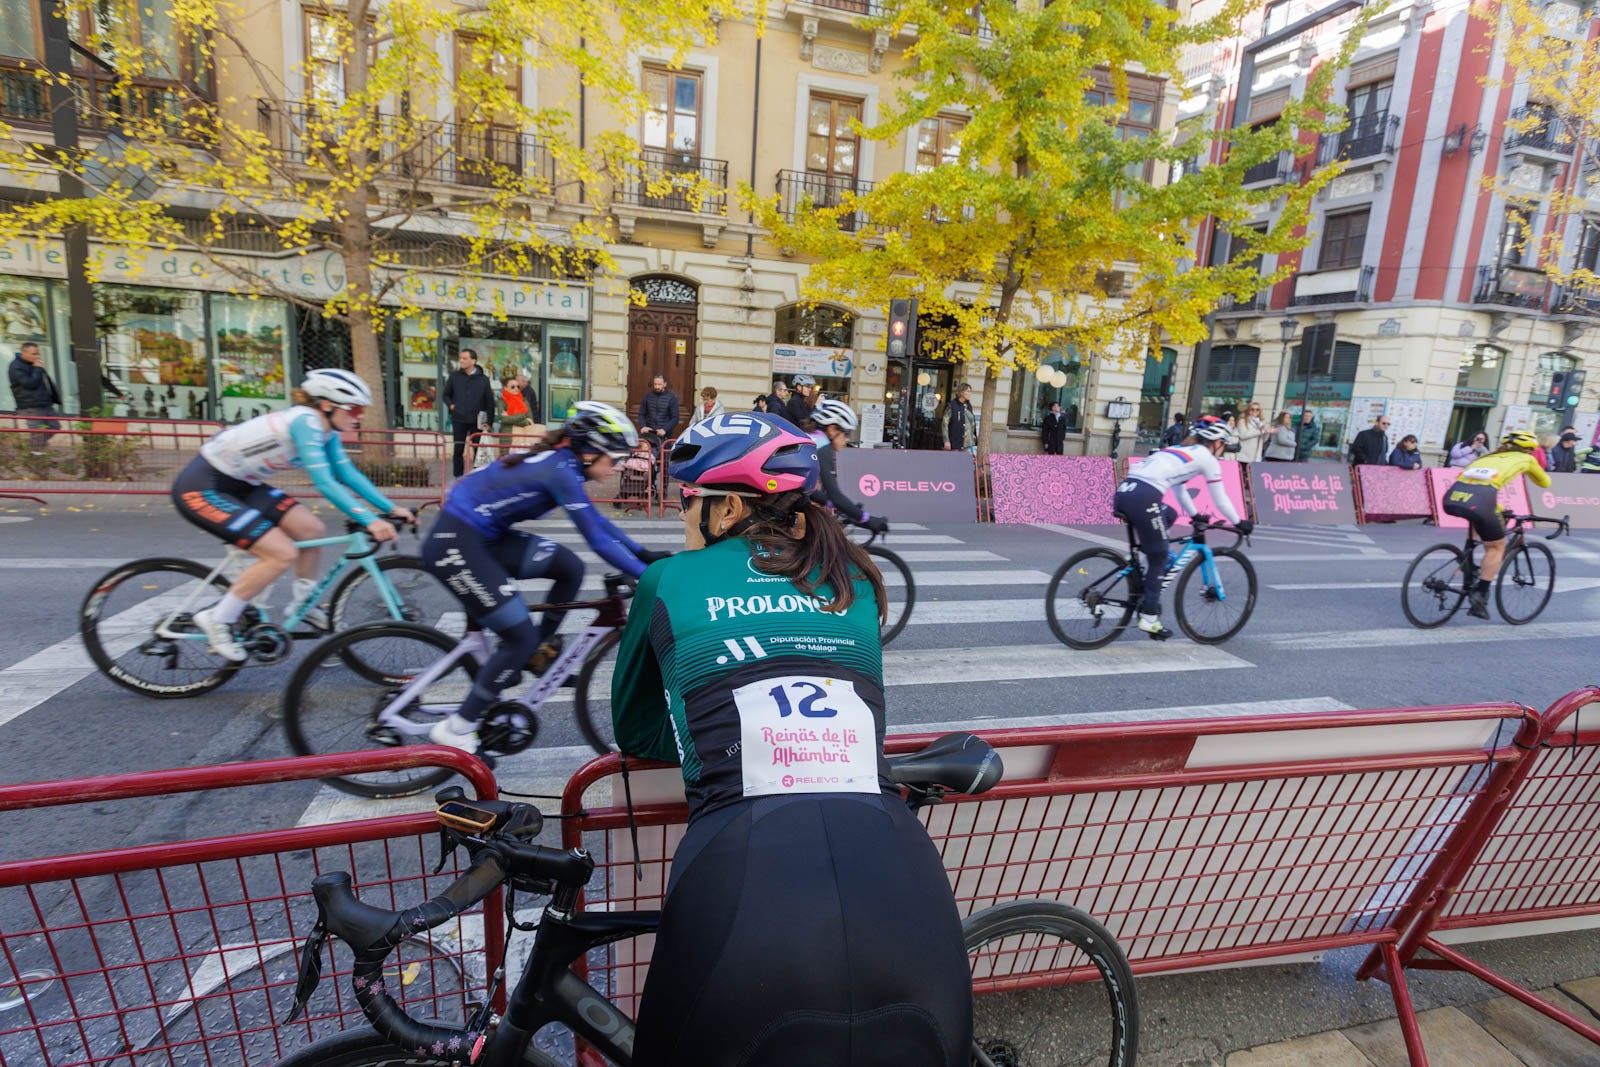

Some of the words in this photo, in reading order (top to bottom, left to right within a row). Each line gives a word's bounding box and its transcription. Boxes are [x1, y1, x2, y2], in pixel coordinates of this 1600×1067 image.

[883, 480, 956, 492] RELEVO
[1555, 496, 1600, 505] RELEVO
[1160, 549, 1198, 593] ANYON
[770, 636, 817, 645] Diputación
[818, 636, 855, 646] Provincial
[808, 643, 837, 652] Málaga
[769, 682, 838, 718] 12
[822, 727, 841, 743] de
[795, 776, 839, 784] RELEVO
